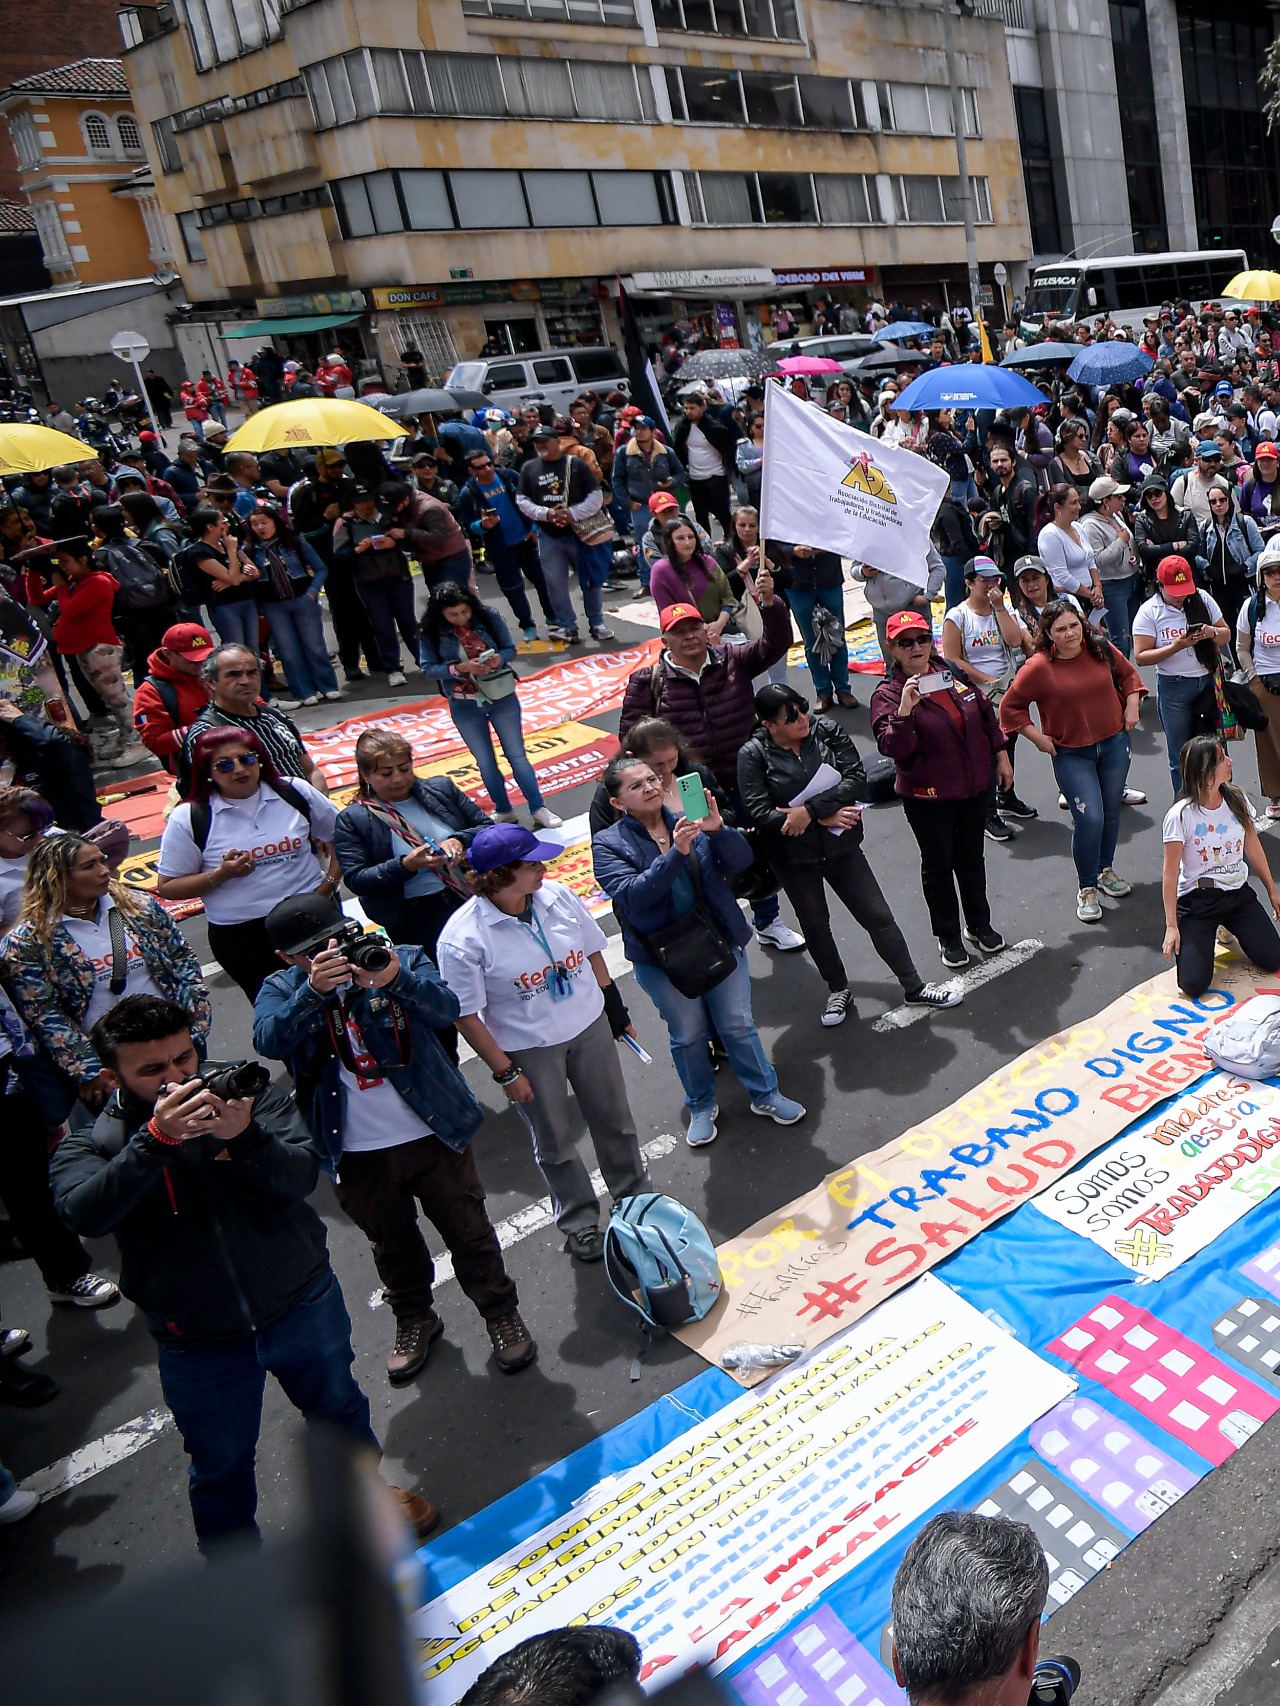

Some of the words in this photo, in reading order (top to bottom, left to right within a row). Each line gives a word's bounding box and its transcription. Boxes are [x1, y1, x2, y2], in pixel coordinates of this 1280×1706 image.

[388, 292, 411, 304] DON
[412, 289, 439, 301] CAFÉ
[829, 495, 865, 512] Trabajadores
[837, 488, 869, 505] Asociación
[868, 499, 891, 514] Distrital
[890, 508, 898, 517] de
[844, 507, 852, 515] de
[859, 511, 887, 528] Educación
[1083, 988, 1236, 1079] DIGNO
[1143, 1074, 1253, 1147] madres
[718, 1218, 821, 1290] POR
[899, 1027, 1107, 1160] DERECHO
[716, 1508, 770, 1549] NO
[776, 1473, 820, 1504] SE
[824, 1344, 999, 1470] IMPROVISA
[797, 1319, 947, 1424] ESTAMOS
[456, 1586, 521, 1635] DE
[525, 1455, 722, 1587] PRIMERA
[722, 1336, 899, 1454] INFANCIA
[486, 1480, 647, 1590] SOMOS
[650, 1343, 853, 1480] MAESTRAS
[618, 1432, 815, 1571] EDUCANDO
[648, 1529, 707, 1574] UN
[709, 1414, 871, 1529] TRABAJO
[874, 1341, 973, 1415] DIGNO
[681, 1494, 849, 1620] NUESTRAS
[855, 1388, 989, 1490] FAMILIAS
[687, 1460, 864, 1594] AFILIACIÓN
[871, 1442, 895, 1459] A
[897, 1369, 988, 1436] SALUD
[762, 1416, 980, 1586] MASACRE
